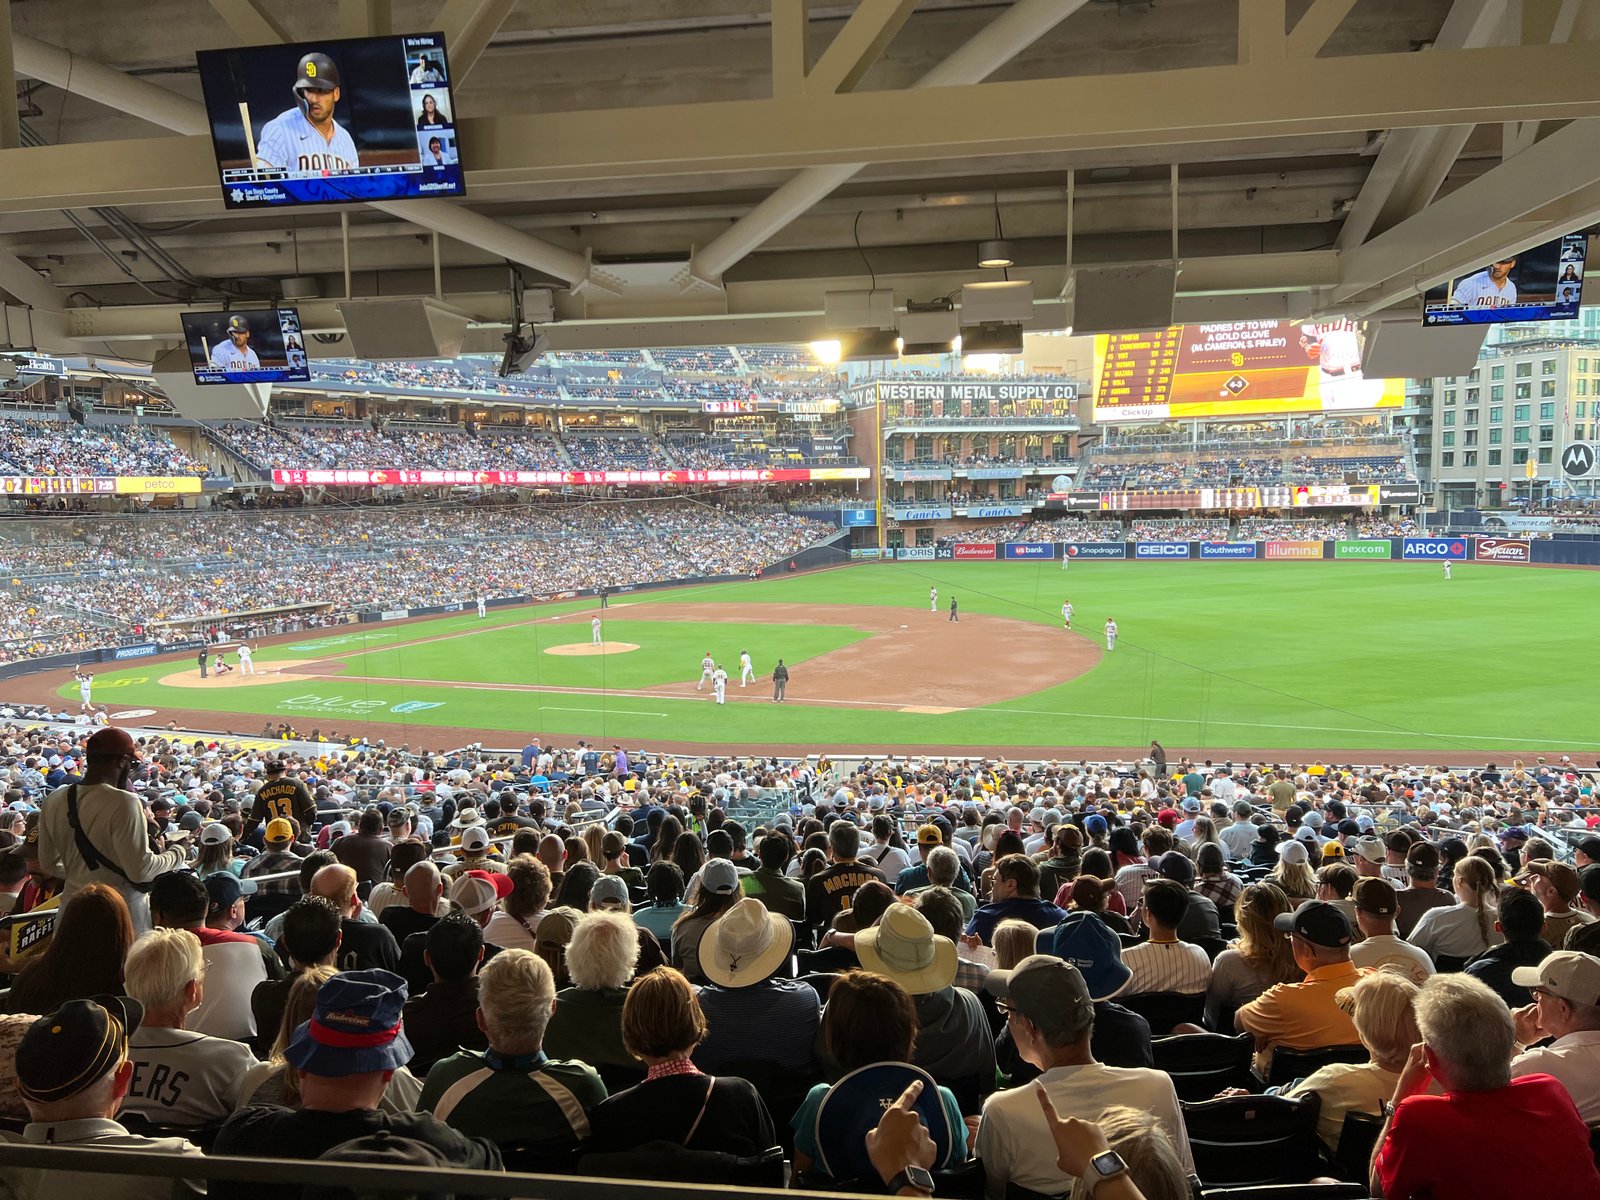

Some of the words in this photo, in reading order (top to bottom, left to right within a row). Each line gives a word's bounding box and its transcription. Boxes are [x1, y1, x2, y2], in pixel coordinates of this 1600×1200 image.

[1200, 323, 1233, 334] PADRES
[1234, 322, 1245, 330] CF
[1247, 321, 1258, 329] TO
[1259, 320, 1278, 329] WIN
[1207, 334, 1215, 342] A
[1215, 332, 1240, 341] GOLD
[1241, 330, 1270, 339] GLOVE
[1191, 344, 1203, 353] (M.
[1204, 340, 1246, 351] CAMERON,
[1247, 340, 1254, 348] S.
[1255, 338, 1286, 347] FINLEY)
[29, 359, 55, 370] Health
[880, 386, 945, 399] WESTERN
[951, 386, 995, 399] METAL
[999, 386, 1049, 399] SUPPLY
[1055, 386, 1076, 399] CO.
[785, 402, 830, 413] CUTWATER
[144, 479, 174, 490] petco
[956, 546, 994, 556] Budweiser
[1081, 546, 1122, 555] Snapdragon
[1138, 544, 1187, 555] GEICO
[1204, 546, 1246, 554] Southwest
[1269, 544, 1318, 556] illumina
[1405, 543, 1448, 554] ARCO
[1479, 540, 1524, 558] Sycuan
[116, 646, 155, 658] PROGRESSIVE
[281, 694, 387, 708] blue
[260, 786, 296, 800] MACHADO
[267, 797, 292, 819] 13
[21, 922, 54, 948] RAFFL
[26, 924, 36, 935] 50
[326, 1012, 370, 1026] Budweiser
[129, 1062, 189, 1107] ERS
